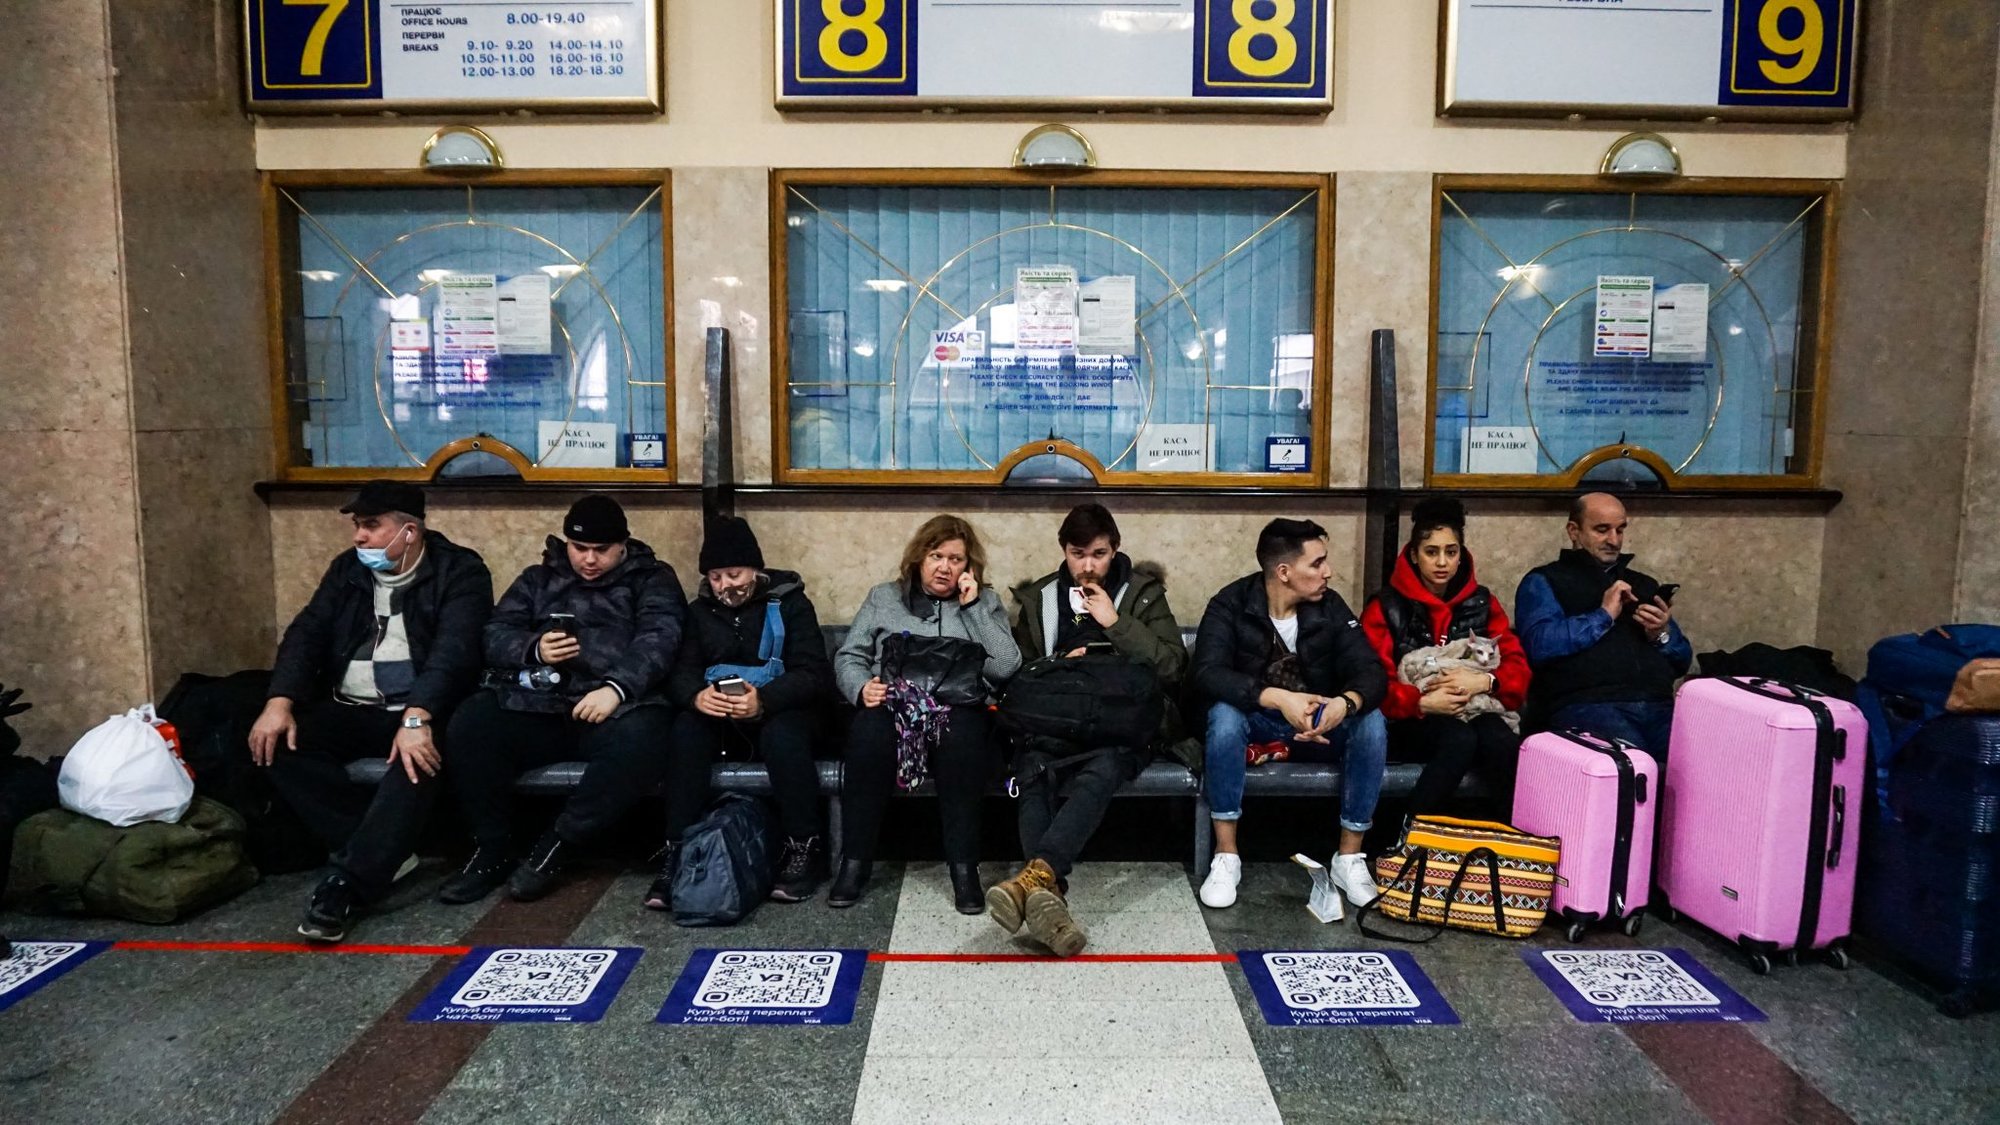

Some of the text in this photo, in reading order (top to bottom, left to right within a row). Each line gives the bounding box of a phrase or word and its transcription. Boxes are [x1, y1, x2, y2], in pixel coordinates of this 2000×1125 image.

[401, 8, 442, 16] ПРАЦЮЄ
[401, 17, 468, 26] OFFICE HOURS
[506, 12, 585, 24] 8.00-19.40
[283, 0, 348, 75] 7
[402, 31, 445, 39] ПЕРЕРВИ
[819, 0, 887, 72] 8
[1230, 0, 1295, 76] 8
[505, 40, 533, 50] 9.20
[1759, 0, 1823, 83] 9
[402, 43, 439, 52] BREAKS
[461, 53, 534, 63] 10.50-11.00
[461, 66, 535, 77] 12.00-13.00
[935, 331, 965, 343] VISA
[564, 429, 591, 438] КАСА
[1487, 431, 1514, 439] КАСА
[1471, 441, 1484, 449] НЕ
[1149, 449, 1159, 457] НЕ
[441, 1005, 481, 1014] Купуй
[482, 1006, 504, 1014] без
[687, 1008, 726, 1017] Купуй
[728, 1008, 750, 1016] без
[1290, 1010, 1329, 1018] Купуй
[1597, 1007, 1636, 1015] Купуй
